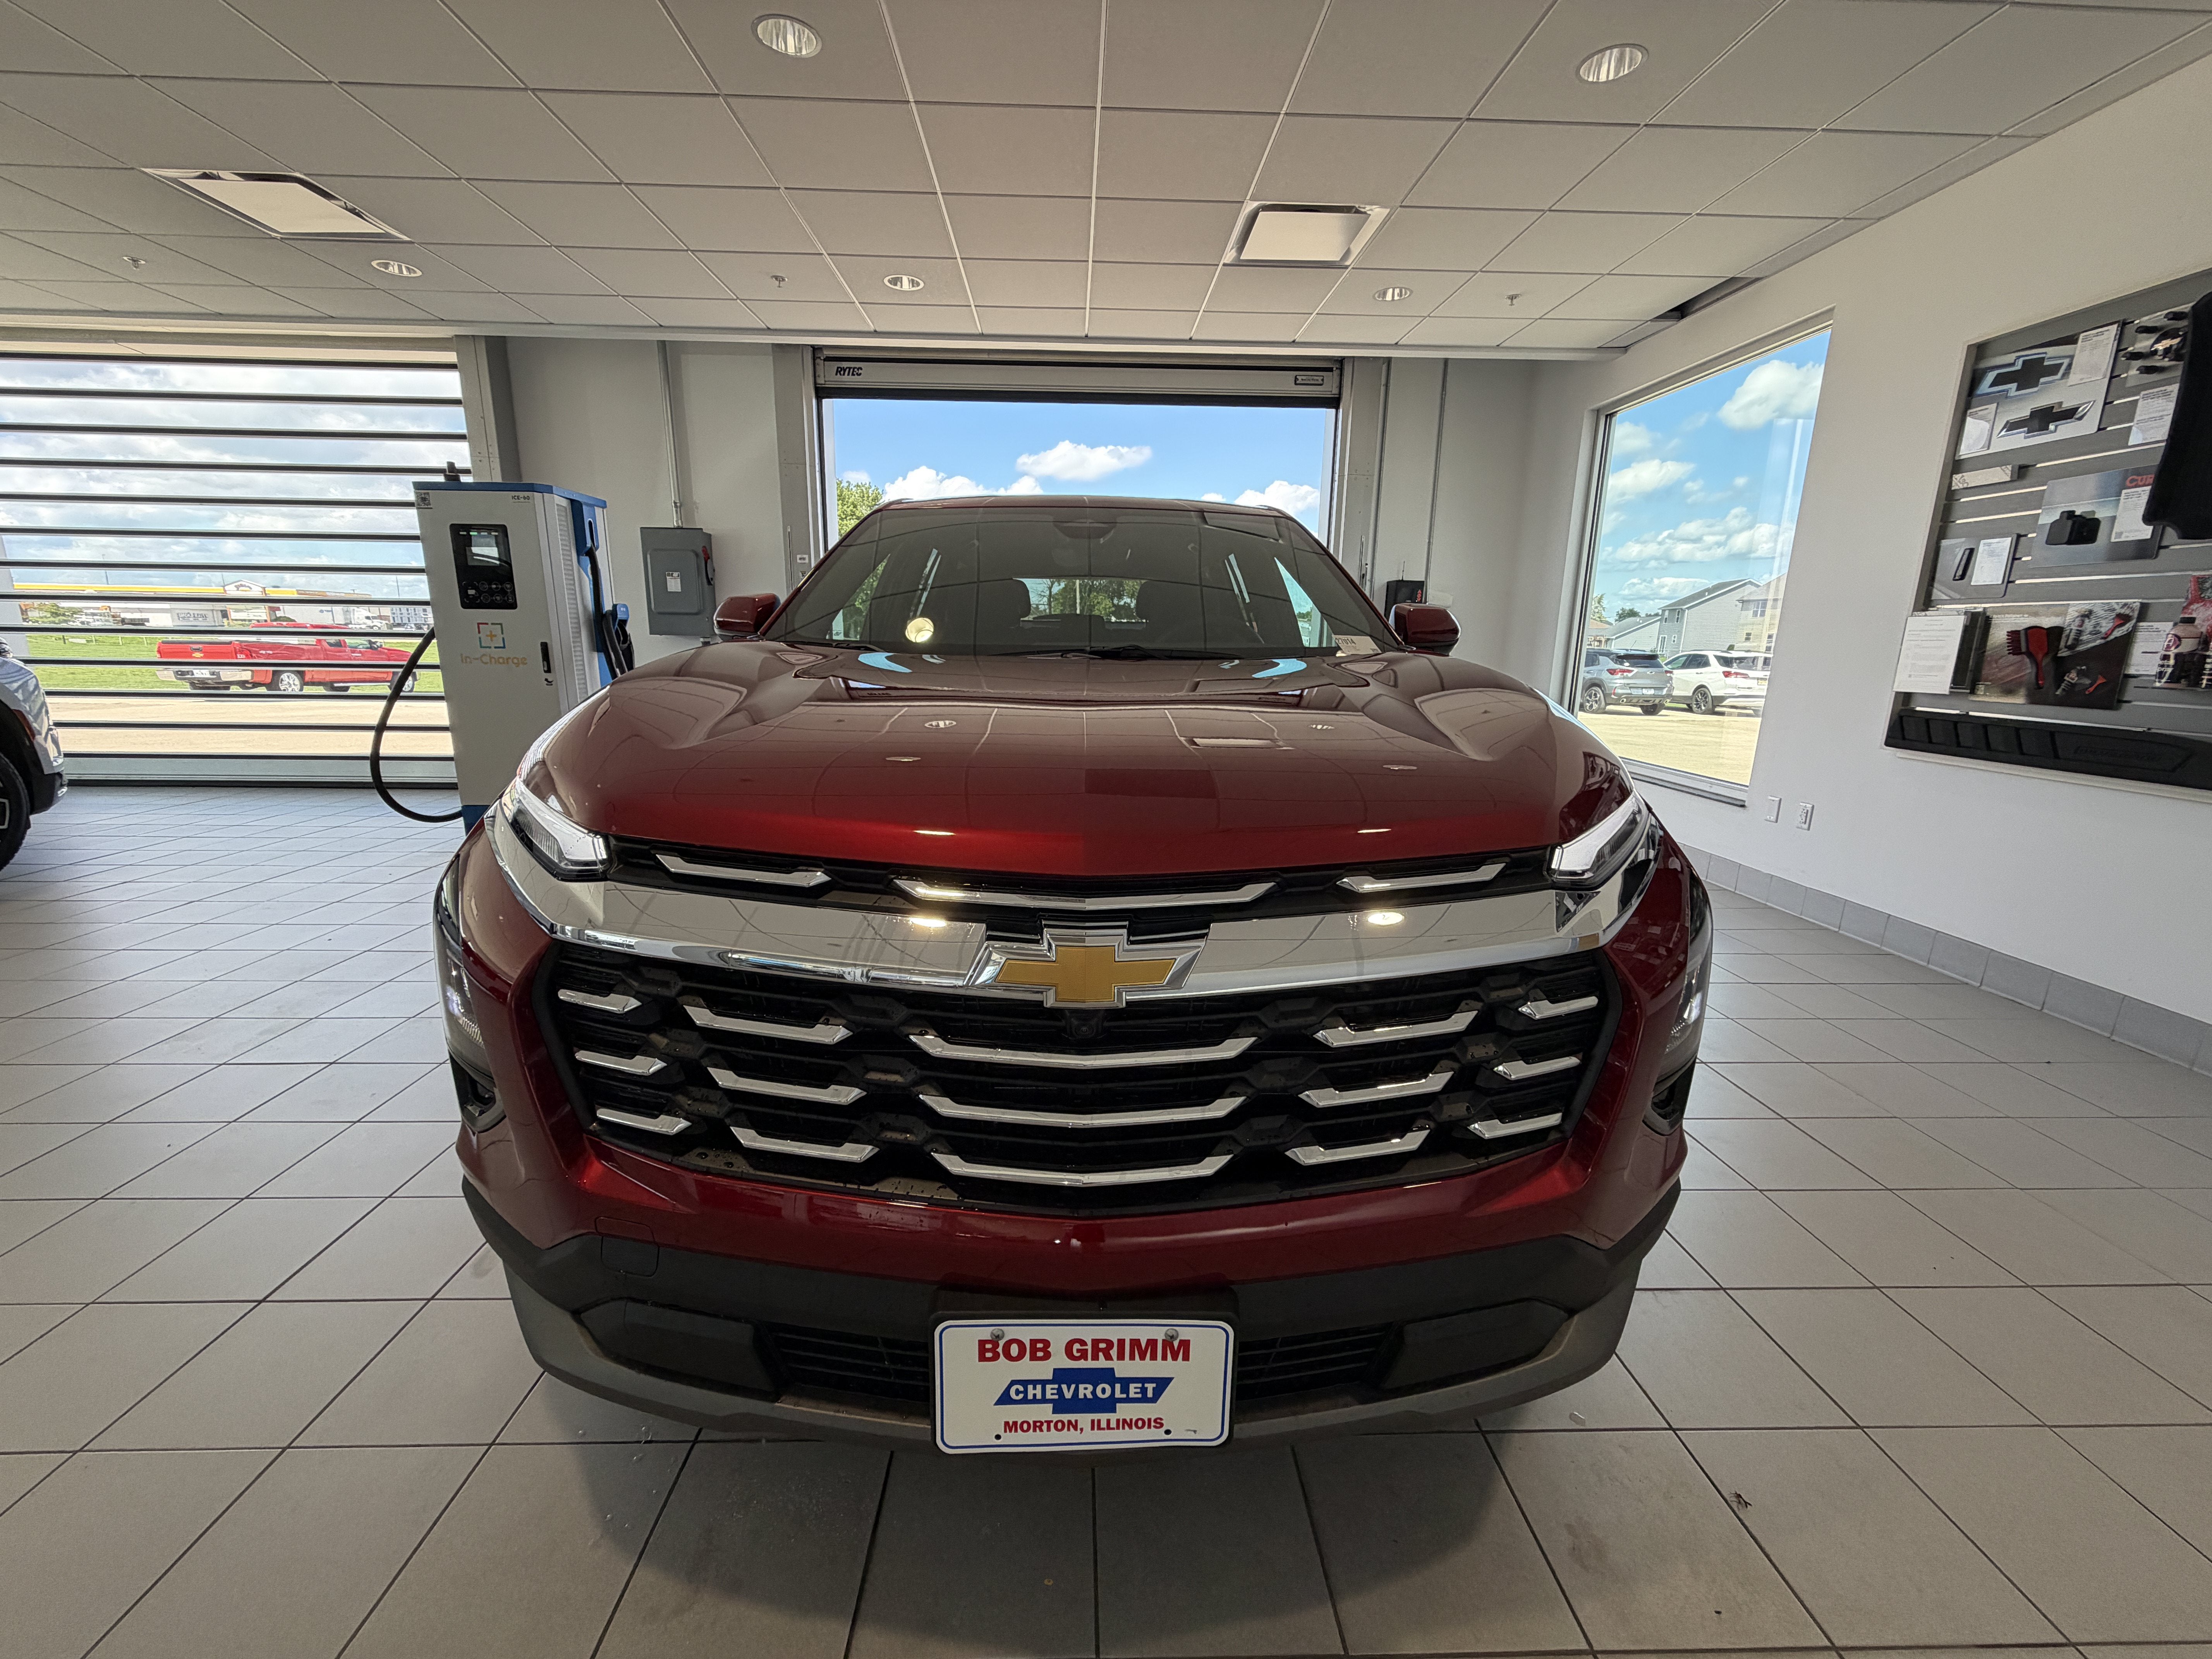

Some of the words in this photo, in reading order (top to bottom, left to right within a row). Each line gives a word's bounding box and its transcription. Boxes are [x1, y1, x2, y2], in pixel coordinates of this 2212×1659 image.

[835, 366, 863, 376] RYTEC
[460, 653, 528, 667] In-Charge
[978, 1338, 1052, 1362] BOB
[1065, 1338, 1191, 1362] GRIMM
[1010, 1383, 1156, 1400] CHEVROLET
[1003, 1419, 1084, 1434] MORTON,
[1091, 1417, 1164, 1431] ILLINOIS
